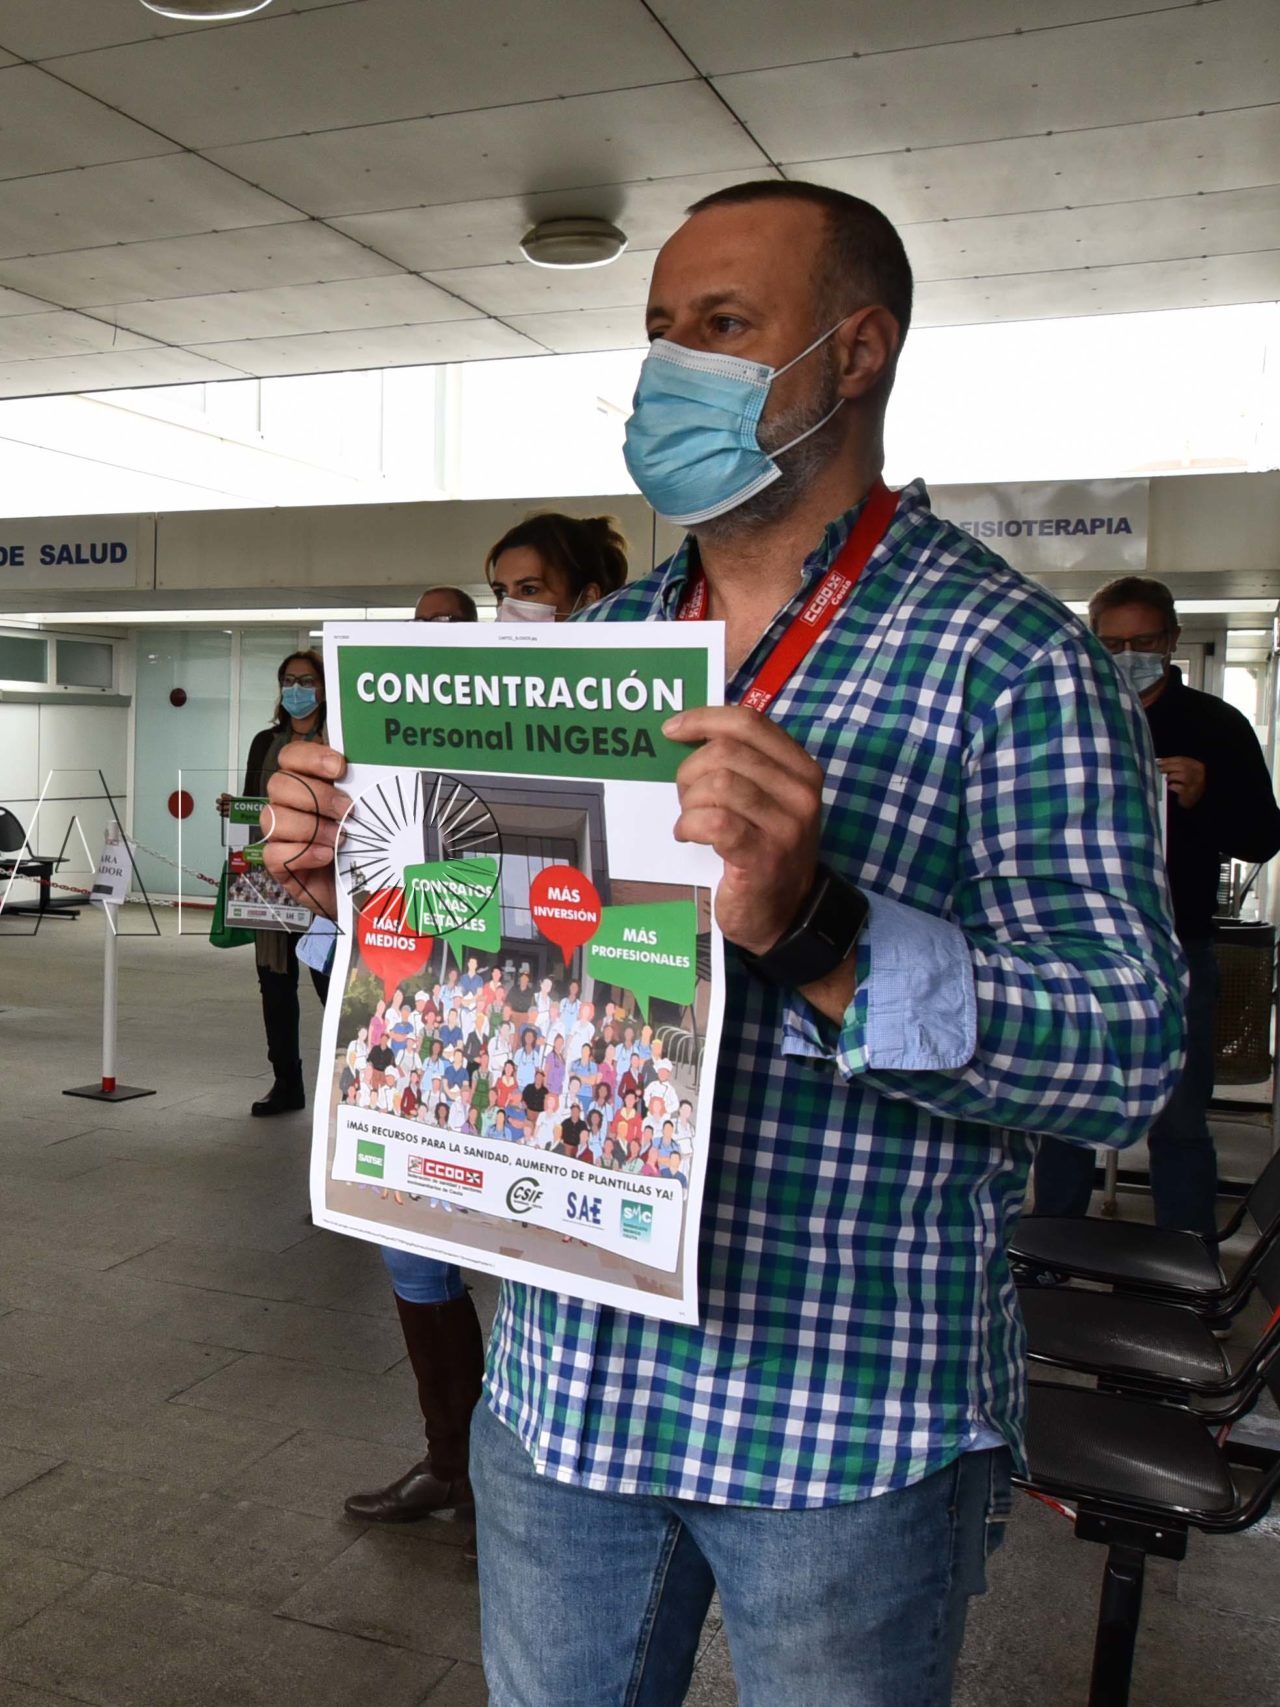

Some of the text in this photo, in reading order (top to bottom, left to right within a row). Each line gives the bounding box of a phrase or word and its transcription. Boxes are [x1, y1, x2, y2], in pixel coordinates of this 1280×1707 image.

[960, 517, 1132, 537] FISIOTERAPIA
[39, 542, 127, 566] SALUD
[831, 580, 852, 606] Ceuta
[804, 587, 833, 623] CCOO
[356, 670, 684, 713] CONCENTRACIÓN
[384, 718, 657, 758] Personal INGESA
[412, 878, 494, 899] CONTRATOS
[548, 884, 581, 903] MÁS
[438, 896, 468, 912] MÁS
[534, 905, 597, 923] INVERSIÓN
[373, 915, 400, 931] MÁS
[423, 914, 486, 932] ESTABLES
[365, 933, 416, 951] MEDIOS
[623, 926, 658, 945] MÁS
[591, 945, 690, 967] PROFESIONALES
[372, 1125, 418, 1144] RECURSOS
[421, 1136, 446, 1150] PARA
[449, 1142, 461, 1154] LA
[463, 1146, 512, 1166] SANIDAD,
[515, 1157, 568, 1177] AUMENTO
[571, 1169, 584, 1181] DE
[588, 1175, 652, 1196] PLANTILLAS
[655, 1188, 674, 1201] YA!
[425, 1161, 465, 1181] CCOO
[513, 1186, 544, 1203] CSIF
